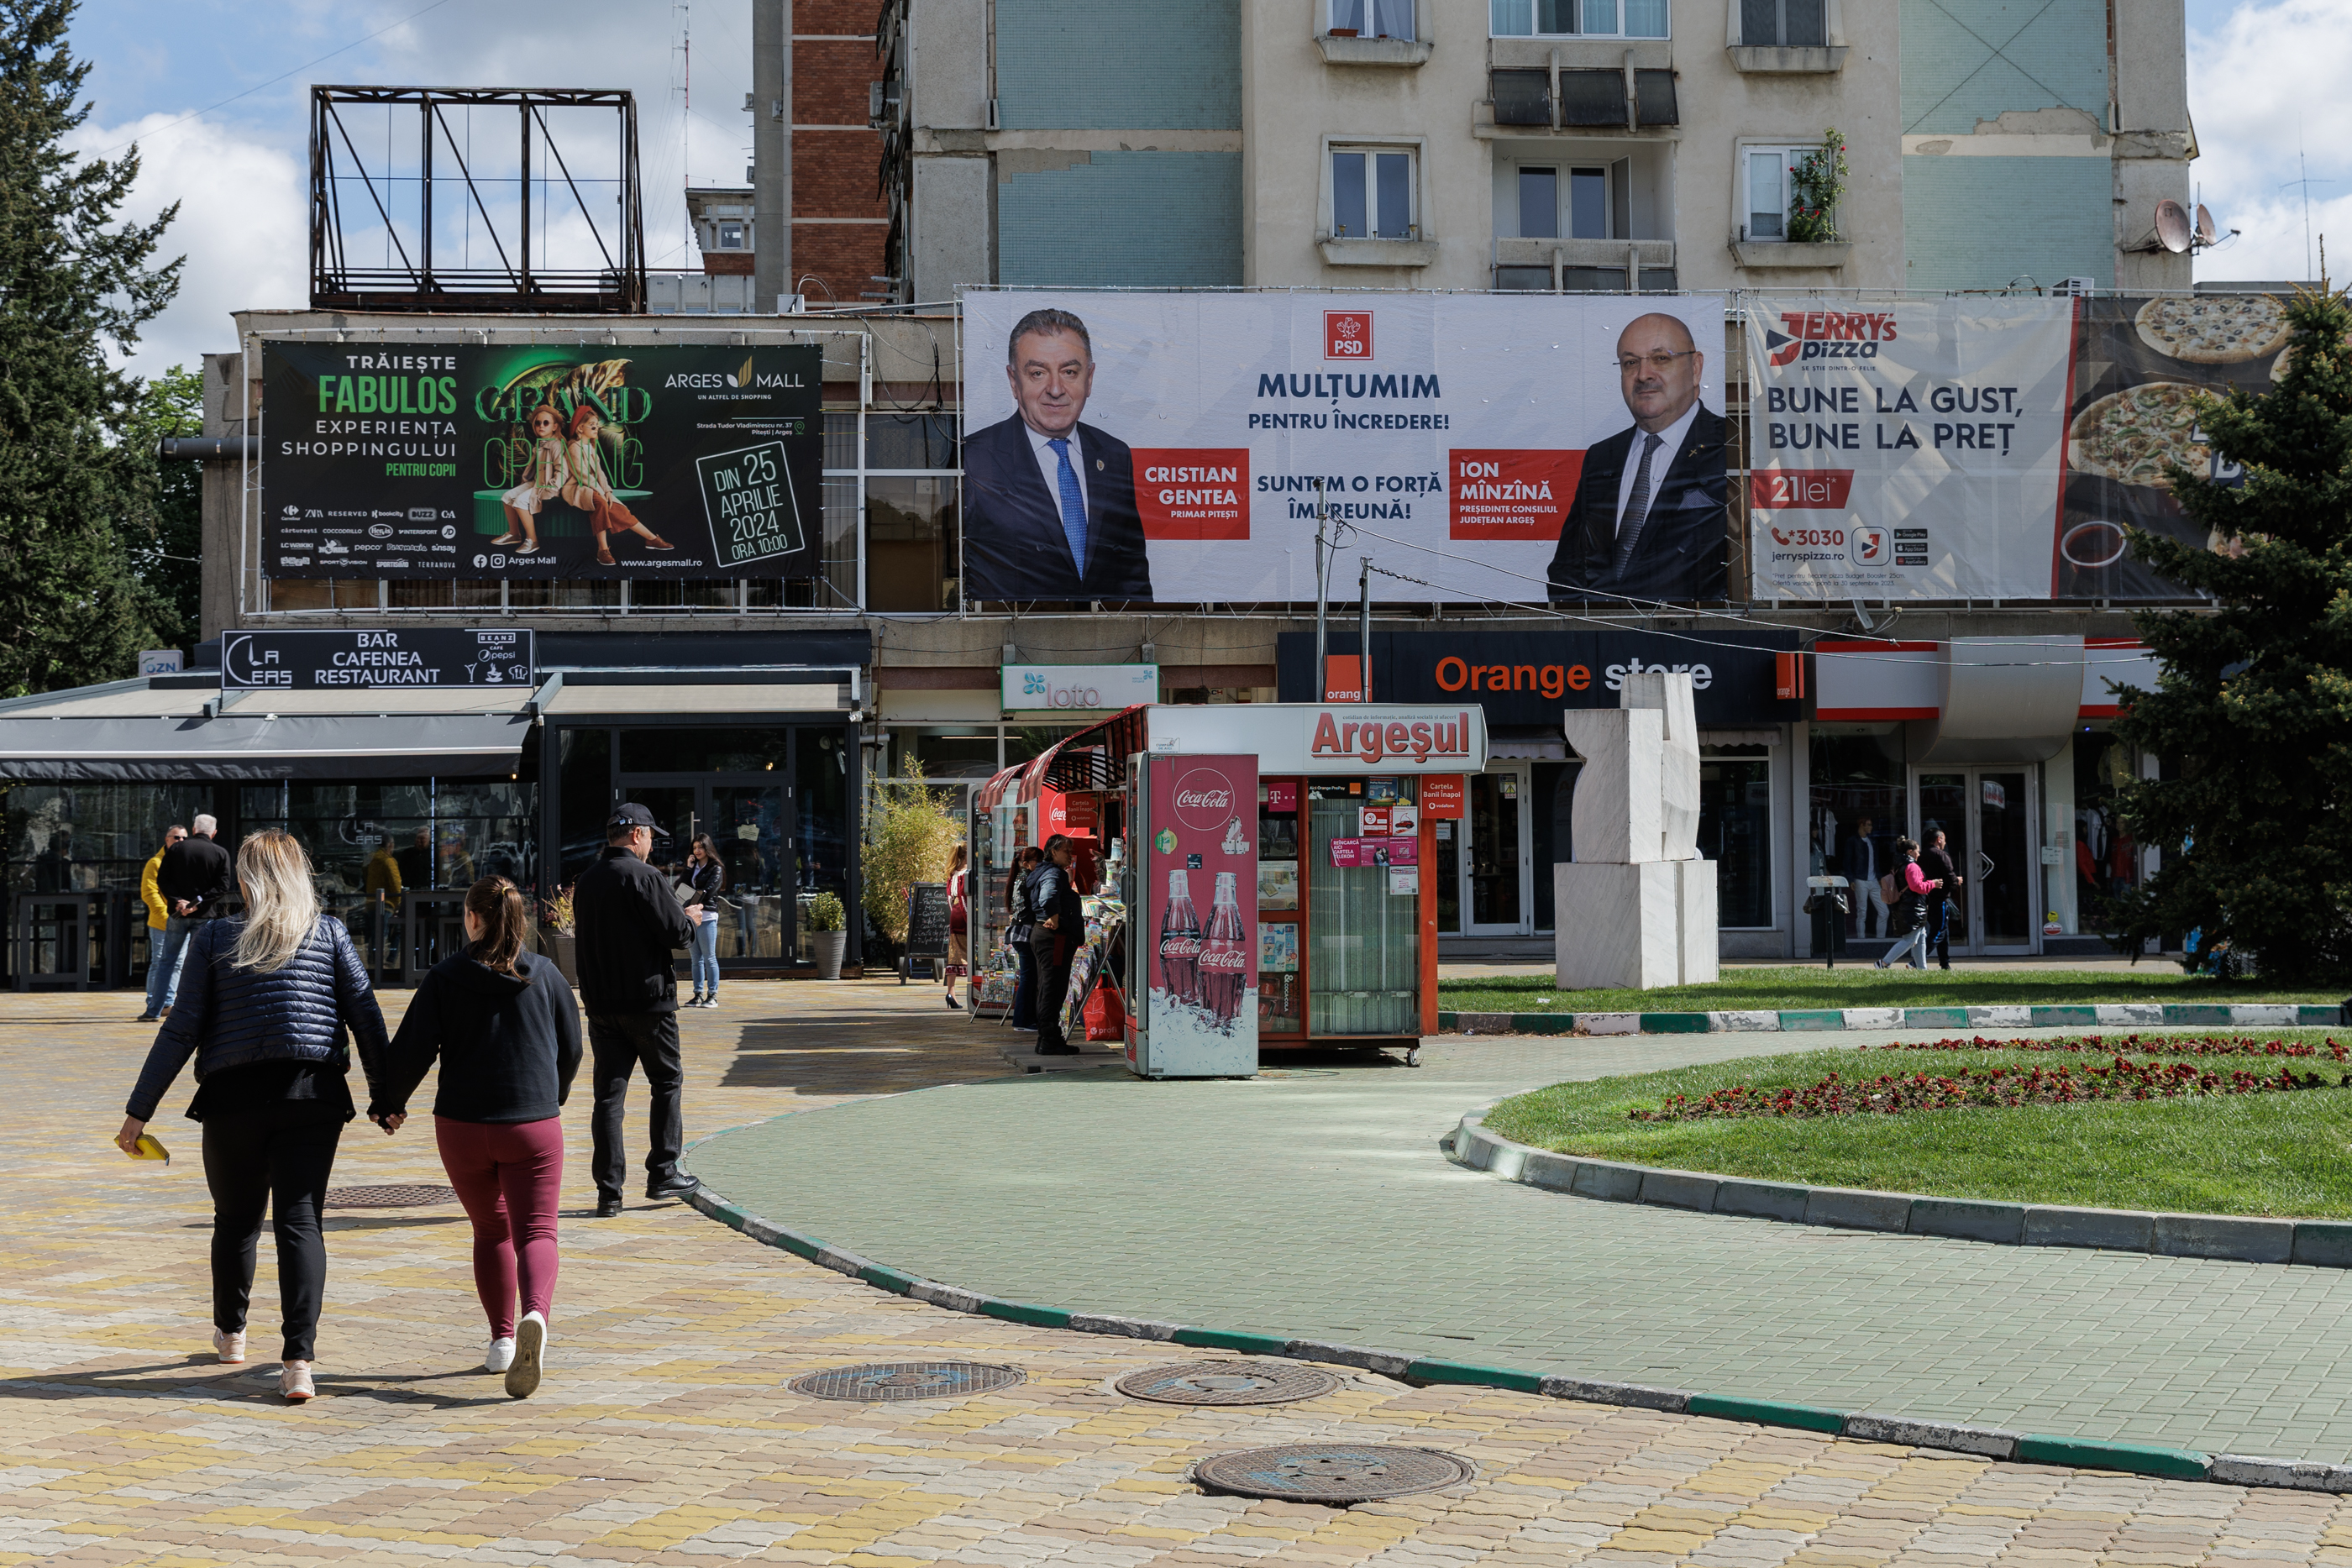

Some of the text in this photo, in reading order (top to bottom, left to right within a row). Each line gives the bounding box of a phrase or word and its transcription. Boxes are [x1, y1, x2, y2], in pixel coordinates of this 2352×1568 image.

[1334, 340, 1362, 354] PSD
[1801, 341, 1879, 360] pizza
[346, 352, 456, 374] TRĂIEȘTE
[664, 373, 805, 388] ARGES MALL
[319, 375, 457, 414] FABULOS
[1257, 373, 1441, 406] MULȚUMIM
[475, 385, 652, 423] GRAND
[1767, 386, 2024, 417] BUNE LA GUST,
[1248, 408, 1449, 430] PENTRU ÎNCREDERE!
[316, 420, 457, 439] EXPERIENȚA
[1769, 422, 2015, 456] BUNE LA PREȚ
[281, 442, 455, 457] SHOPPINGULUI
[386, 463, 456, 477] PENTRU COPII
[484, 438, 643, 489] OPENING
[714, 450, 776, 492] DIN 25
[1460, 462, 1499, 478] ION
[1144, 467, 1237, 483] CRISTIAN
[1257, 471, 1442, 498] SUNTM O FORȚĂ
[1460, 479, 1553, 500] MÎNZÎNĂ
[722, 484, 784, 518] APRILIE
[1158, 489, 1238, 505] GENTEA
[441, 510, 456, 519] C&A
[1208, 511, 1238, 520] PITEȘTI
[1459, 505, 1510, 515] PREȘEDINTE
[730, 510, 780, 542] 2024
[1459, 517, 1535, 526] JUDEȚEAN ARGEȘ
[431, 543, 456, 553] sinsay
[731, 534, 788, 560] ORA 10:00
[508, 556, 556, 565] Arges Mall
[621, 558, 703, 569] www.argesmall.ro
[1772, 551, 1845, 563] jerryspizza.ro
[357, 633, 398, 648] BAR
[333, 652, 423, 666] CAFENEA
[491, 651, 516, 660] pepsi
[146, 663, 176, 673] OZN
[315, 669, 441, 684] RESTAURANT
[1436, 656, 1591, 699] Orange
[1047, 682, 1102, 707] loto
[1327, 690, 1361, 701] orang
[1177, 789, 1231, 808] Coca-Cola
[1441, 789, 1461, 800] Înapoi
[1159, 938, 1202, 955] Coca-Cola
[1198, 949, 1247, 968] Coca-Cola
[1099, 1026, 1117, 1035] profi
